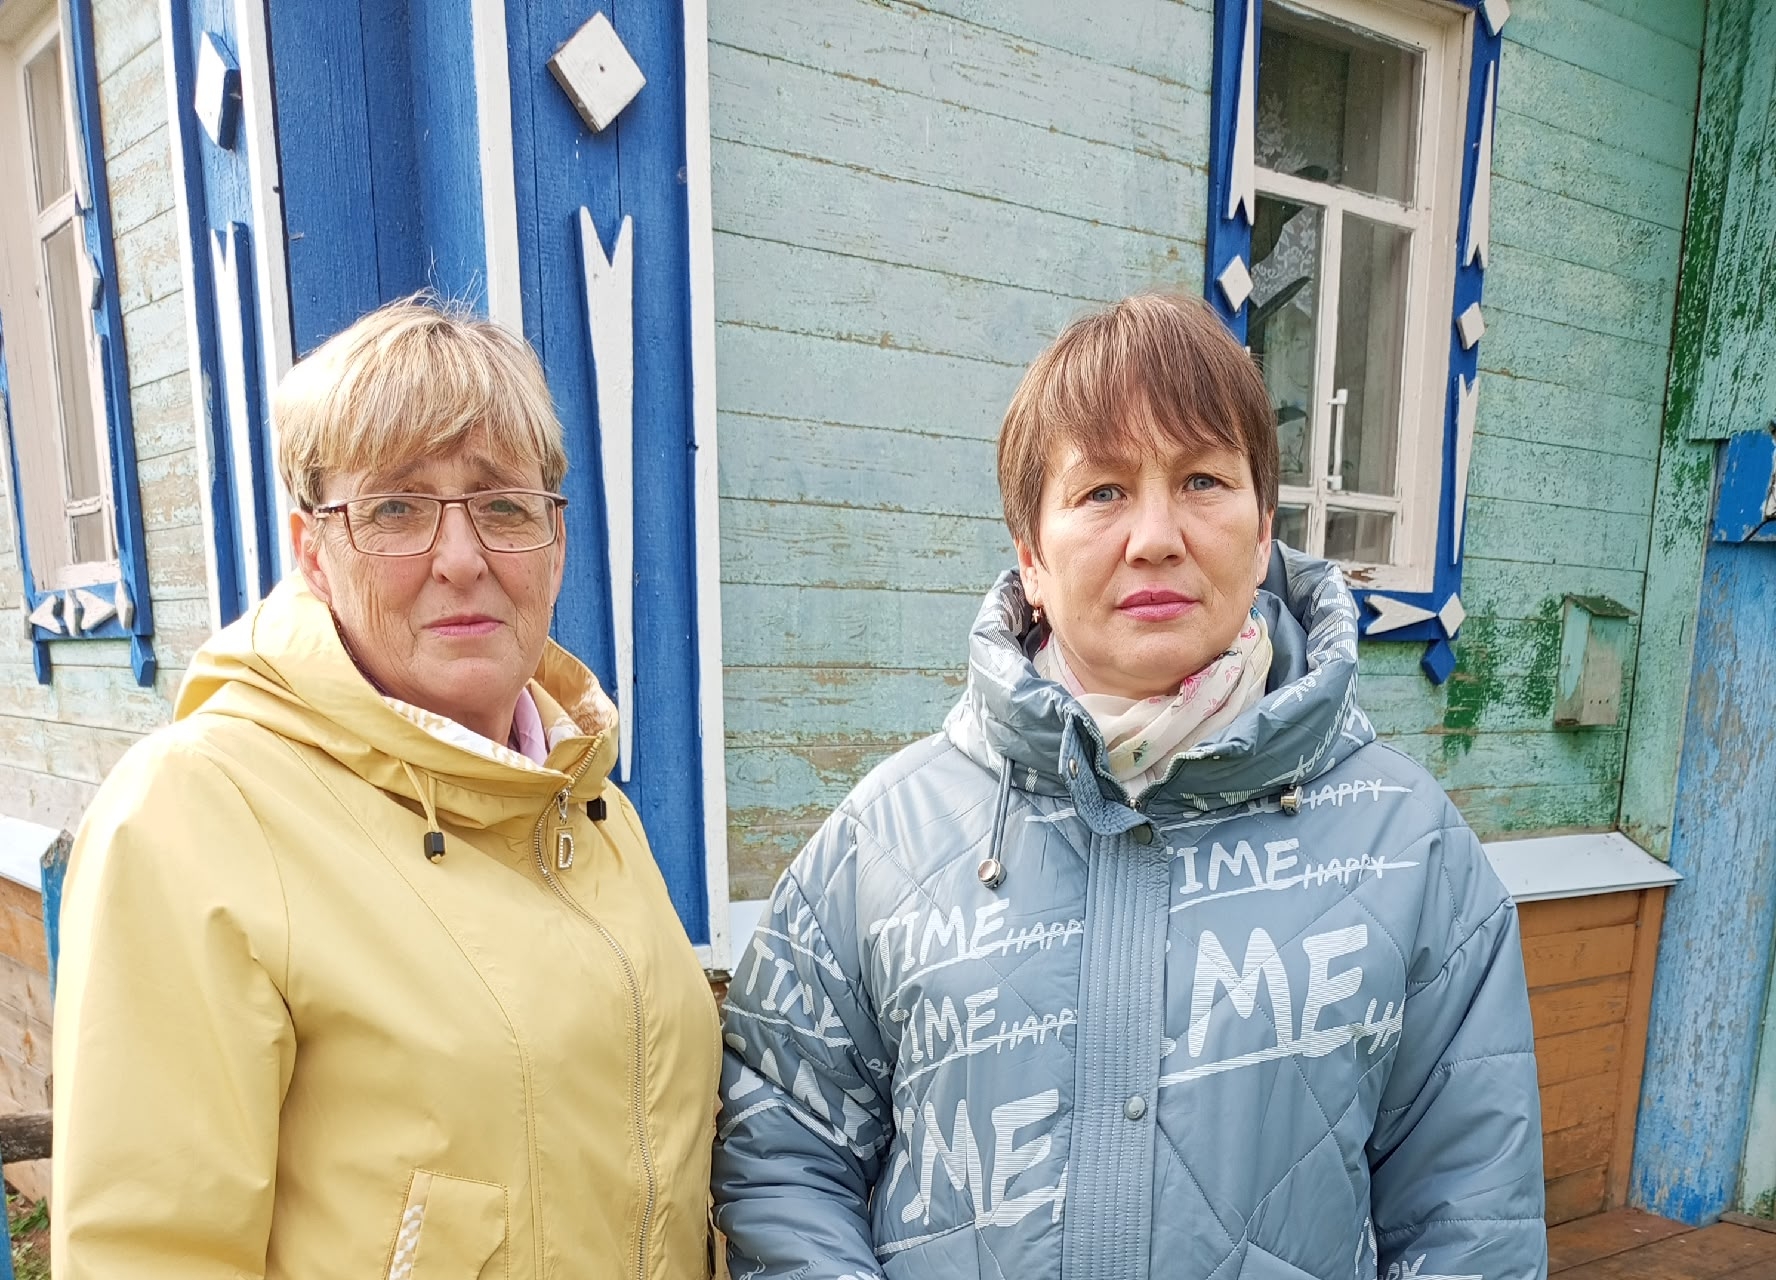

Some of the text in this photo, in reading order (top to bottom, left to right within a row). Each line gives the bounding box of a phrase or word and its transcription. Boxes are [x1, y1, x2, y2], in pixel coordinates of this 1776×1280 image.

[1167, 838, 1386, 894] IME HAPPY
[870, 898, 1010, 979] TIME
[1001, 919, 1084, 957] HAPP
[996, 1008, 1077, 1054] HAPP
